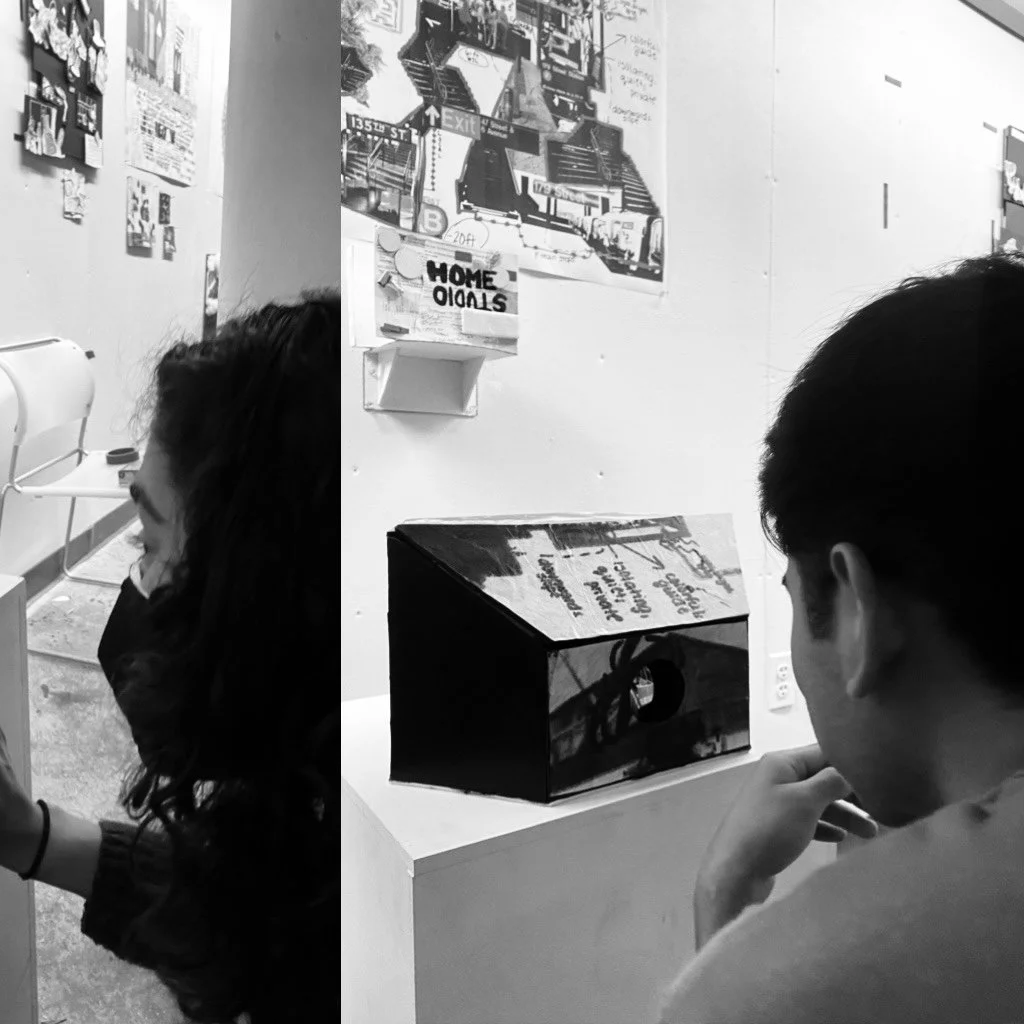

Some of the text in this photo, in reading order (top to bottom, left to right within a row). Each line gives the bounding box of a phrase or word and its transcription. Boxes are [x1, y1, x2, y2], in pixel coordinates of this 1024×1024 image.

[423, 207, 443, 235] B
[426, 260, 498, 291] HOME
[432, 285, 508, 313] STUDIO
